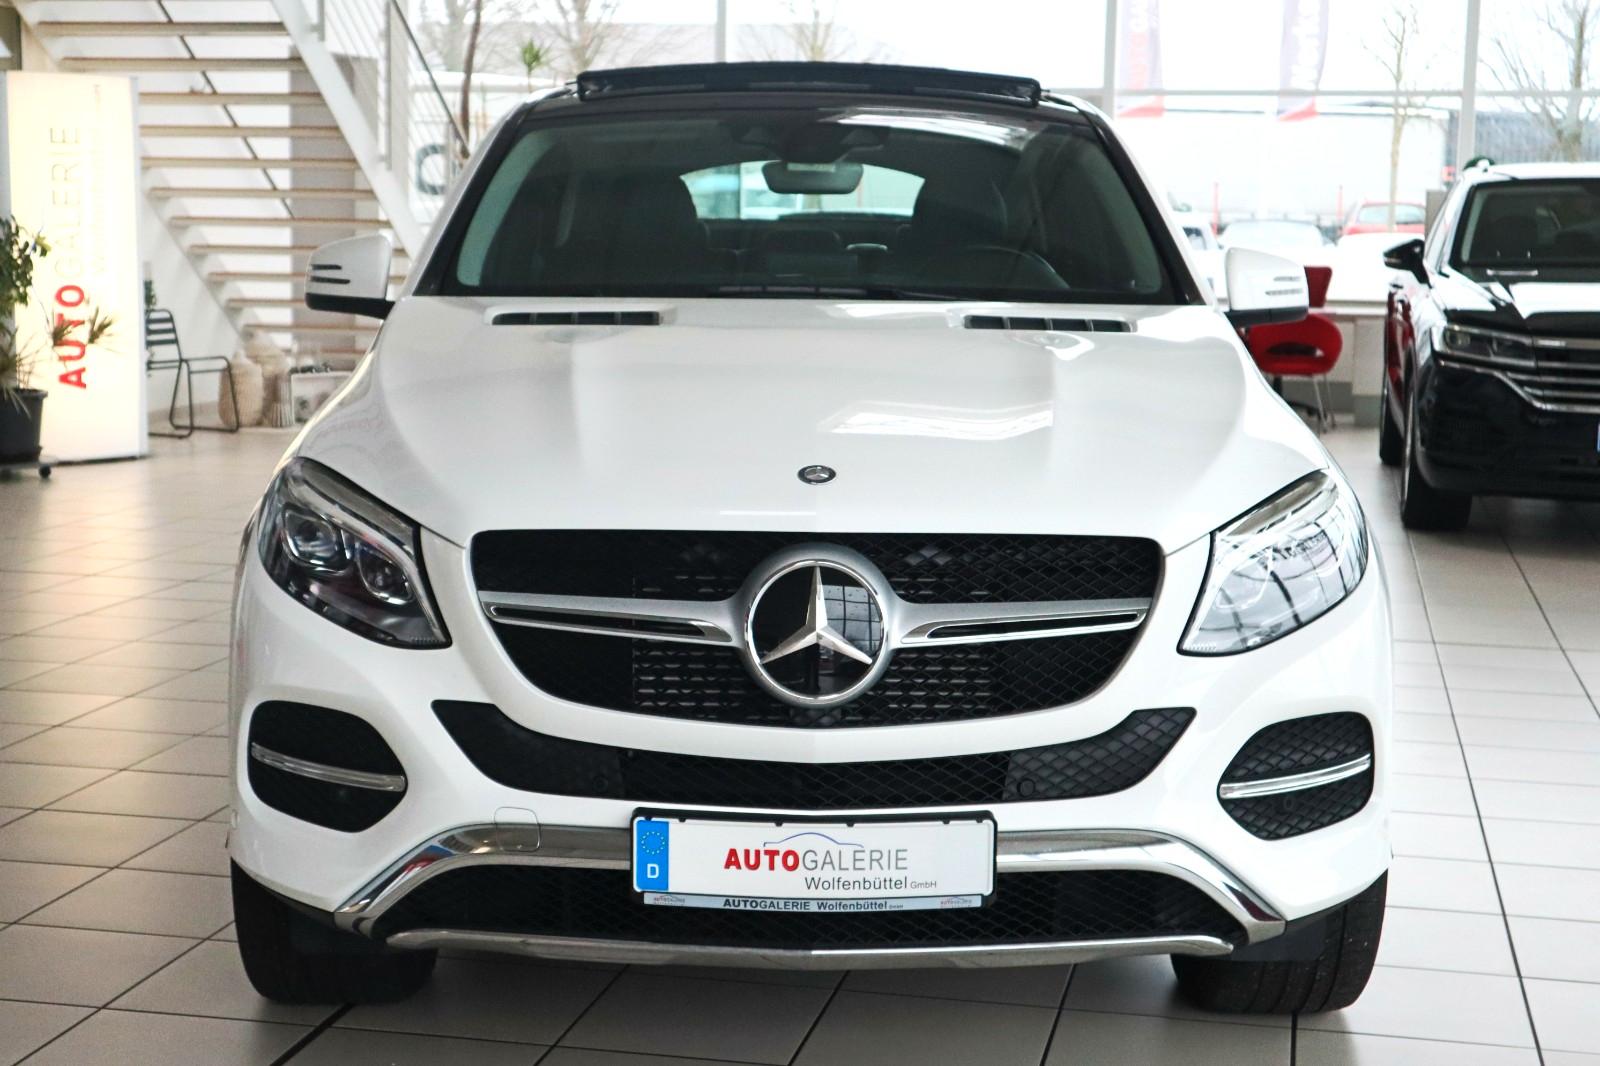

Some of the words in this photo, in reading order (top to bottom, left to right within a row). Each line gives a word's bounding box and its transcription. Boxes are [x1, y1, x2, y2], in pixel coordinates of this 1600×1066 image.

[723, 847, 908, 871] AUTOGALERIE
[646, 863, 659, 879] D
[804, 876, 908, 891] Wolfenbüttel
[910, 880, 937, 889] GmbH
[723, 898, 811, 911] AUTOGALERIE
[817, 901, 888, 911] Wolfenbüttel
